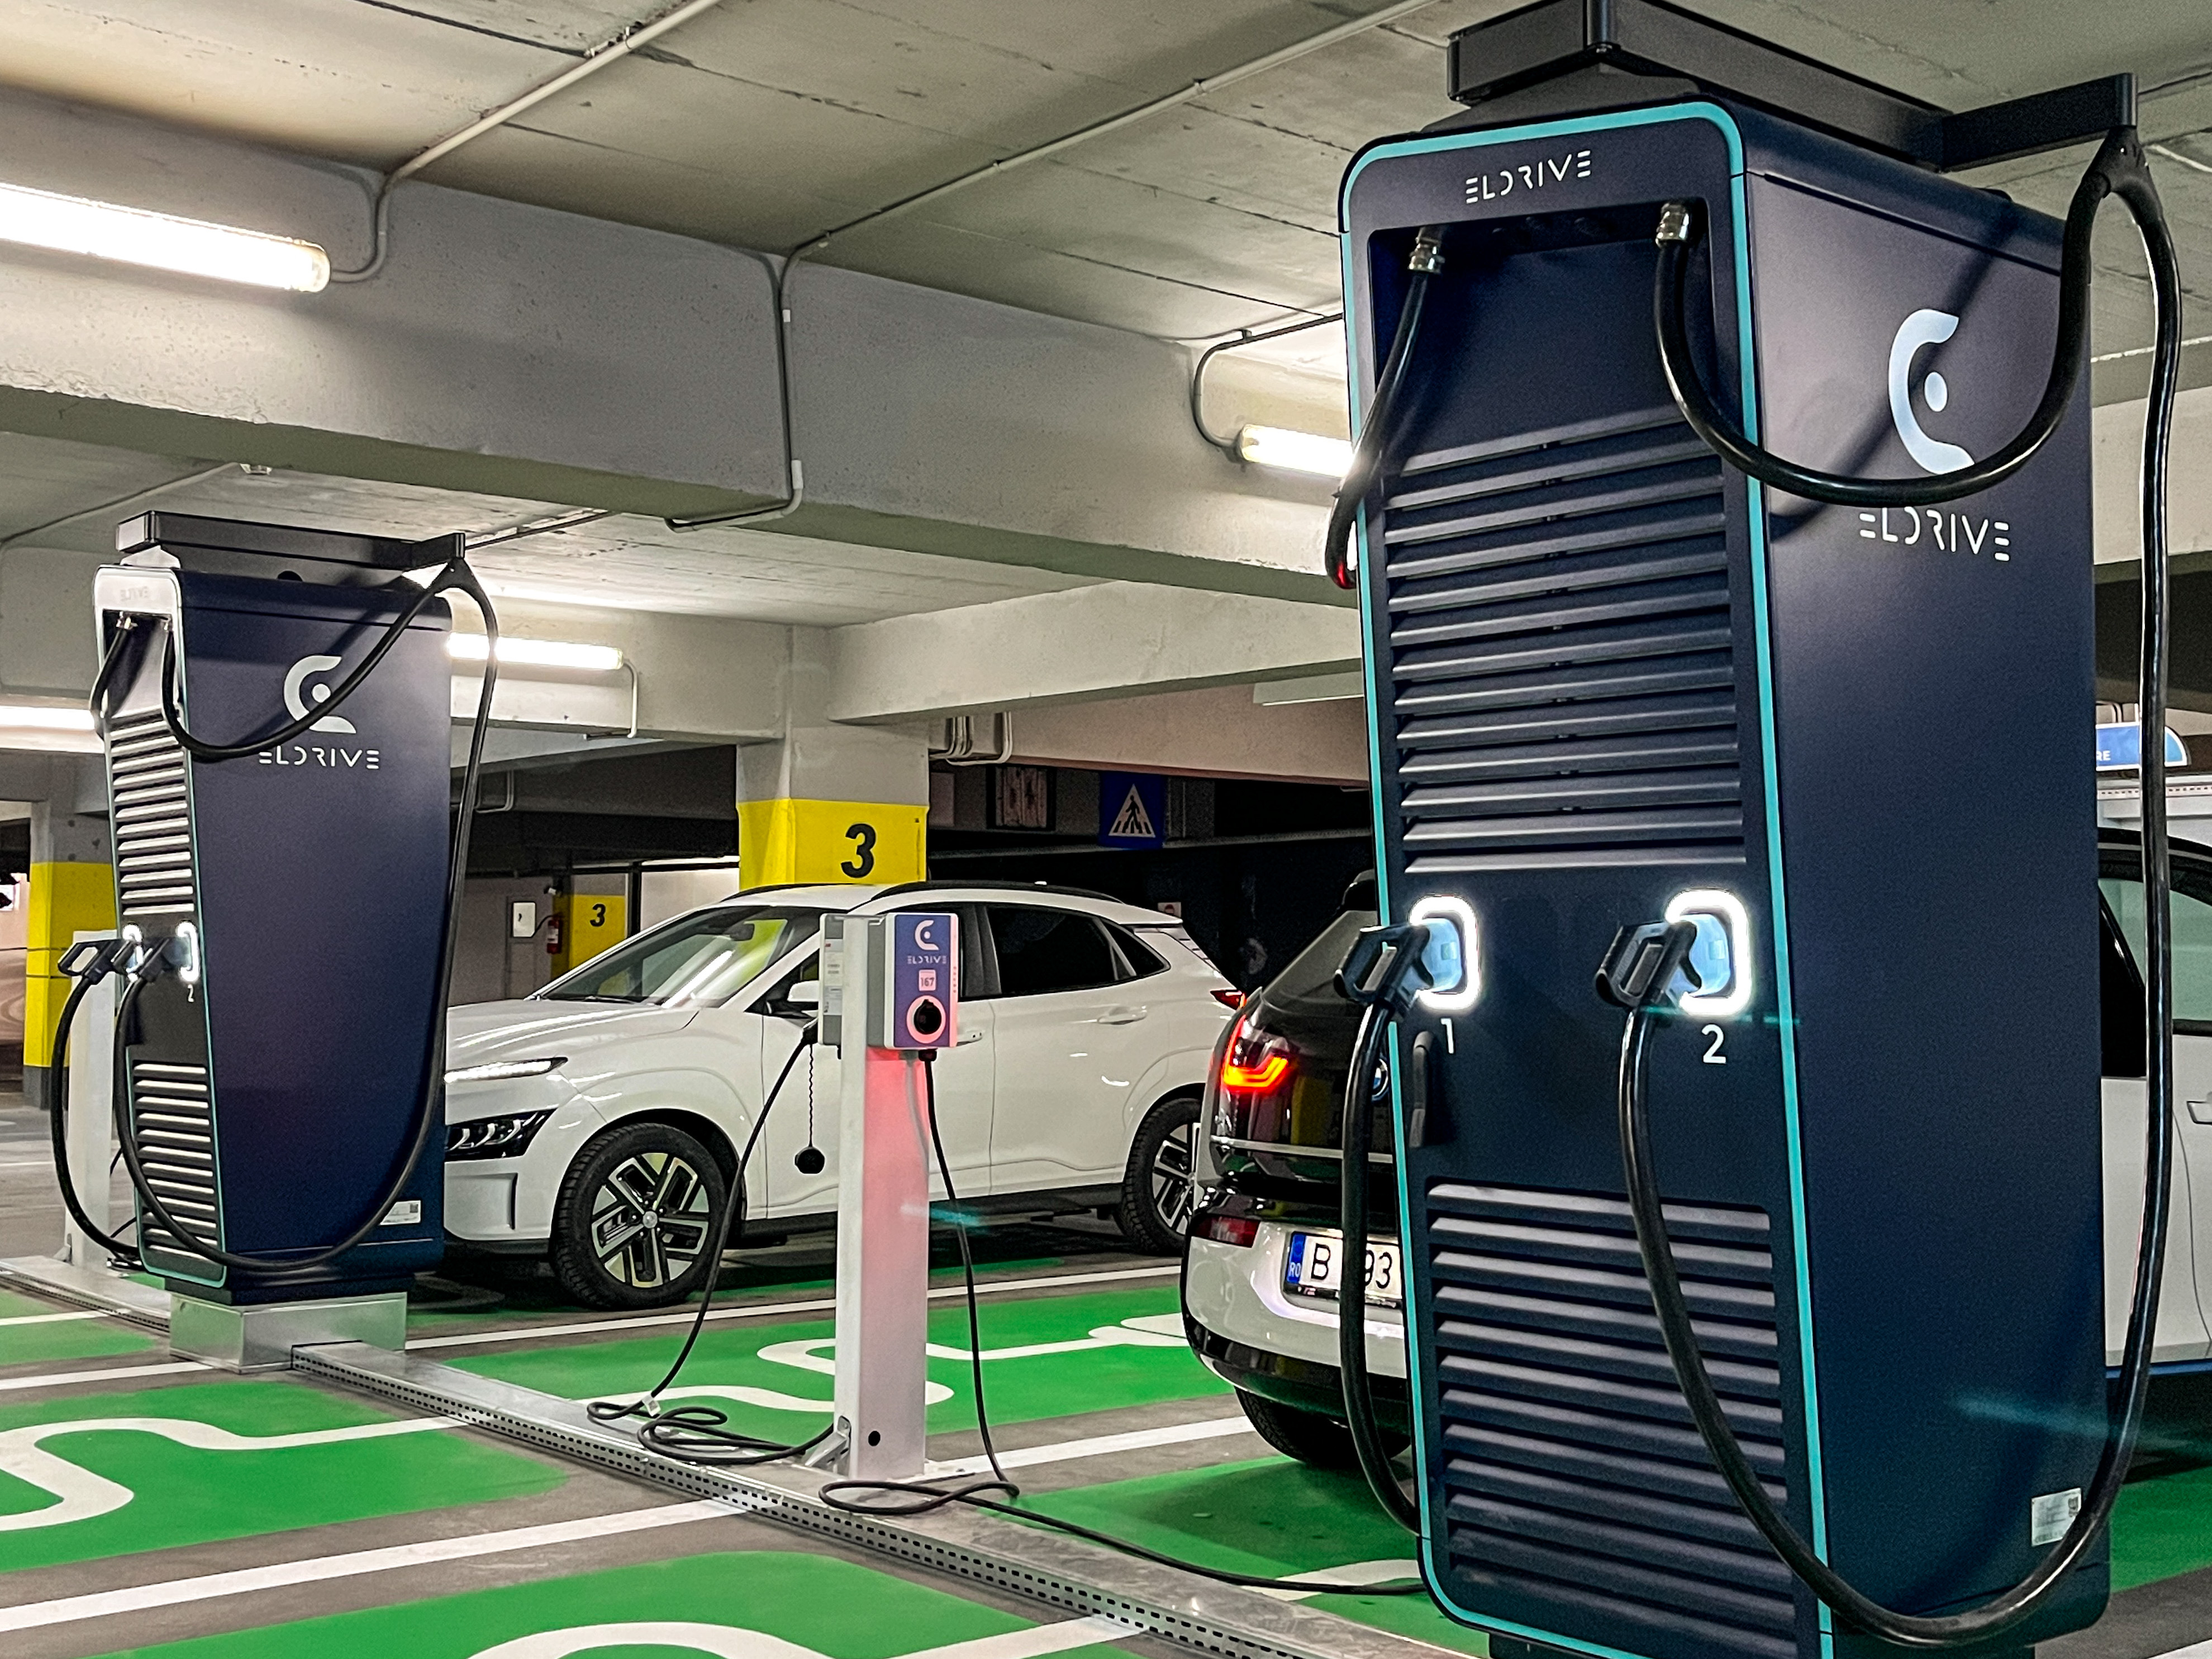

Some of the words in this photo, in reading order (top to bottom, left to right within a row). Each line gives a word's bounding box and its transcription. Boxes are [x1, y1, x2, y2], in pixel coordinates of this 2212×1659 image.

[1466, 149, 1592, 204] ELDRIVE
[1859, 506, 2010, 562] ELDRIVE
[259, 745, 379, 769] ELDRIVE
[840, 823, 877, 878] 3
[590, 904, 606, 927] 3
[907, 956, 947, 964] ELDRIVE
[187, 984, 194, 1002] 2
[920, 977, 935, 987] 167
[1440, 1018, 1454, 1054] 1
[1701, 1024, 1726, 1064] 2
[1289, 1262, 1301, 1278] RO
